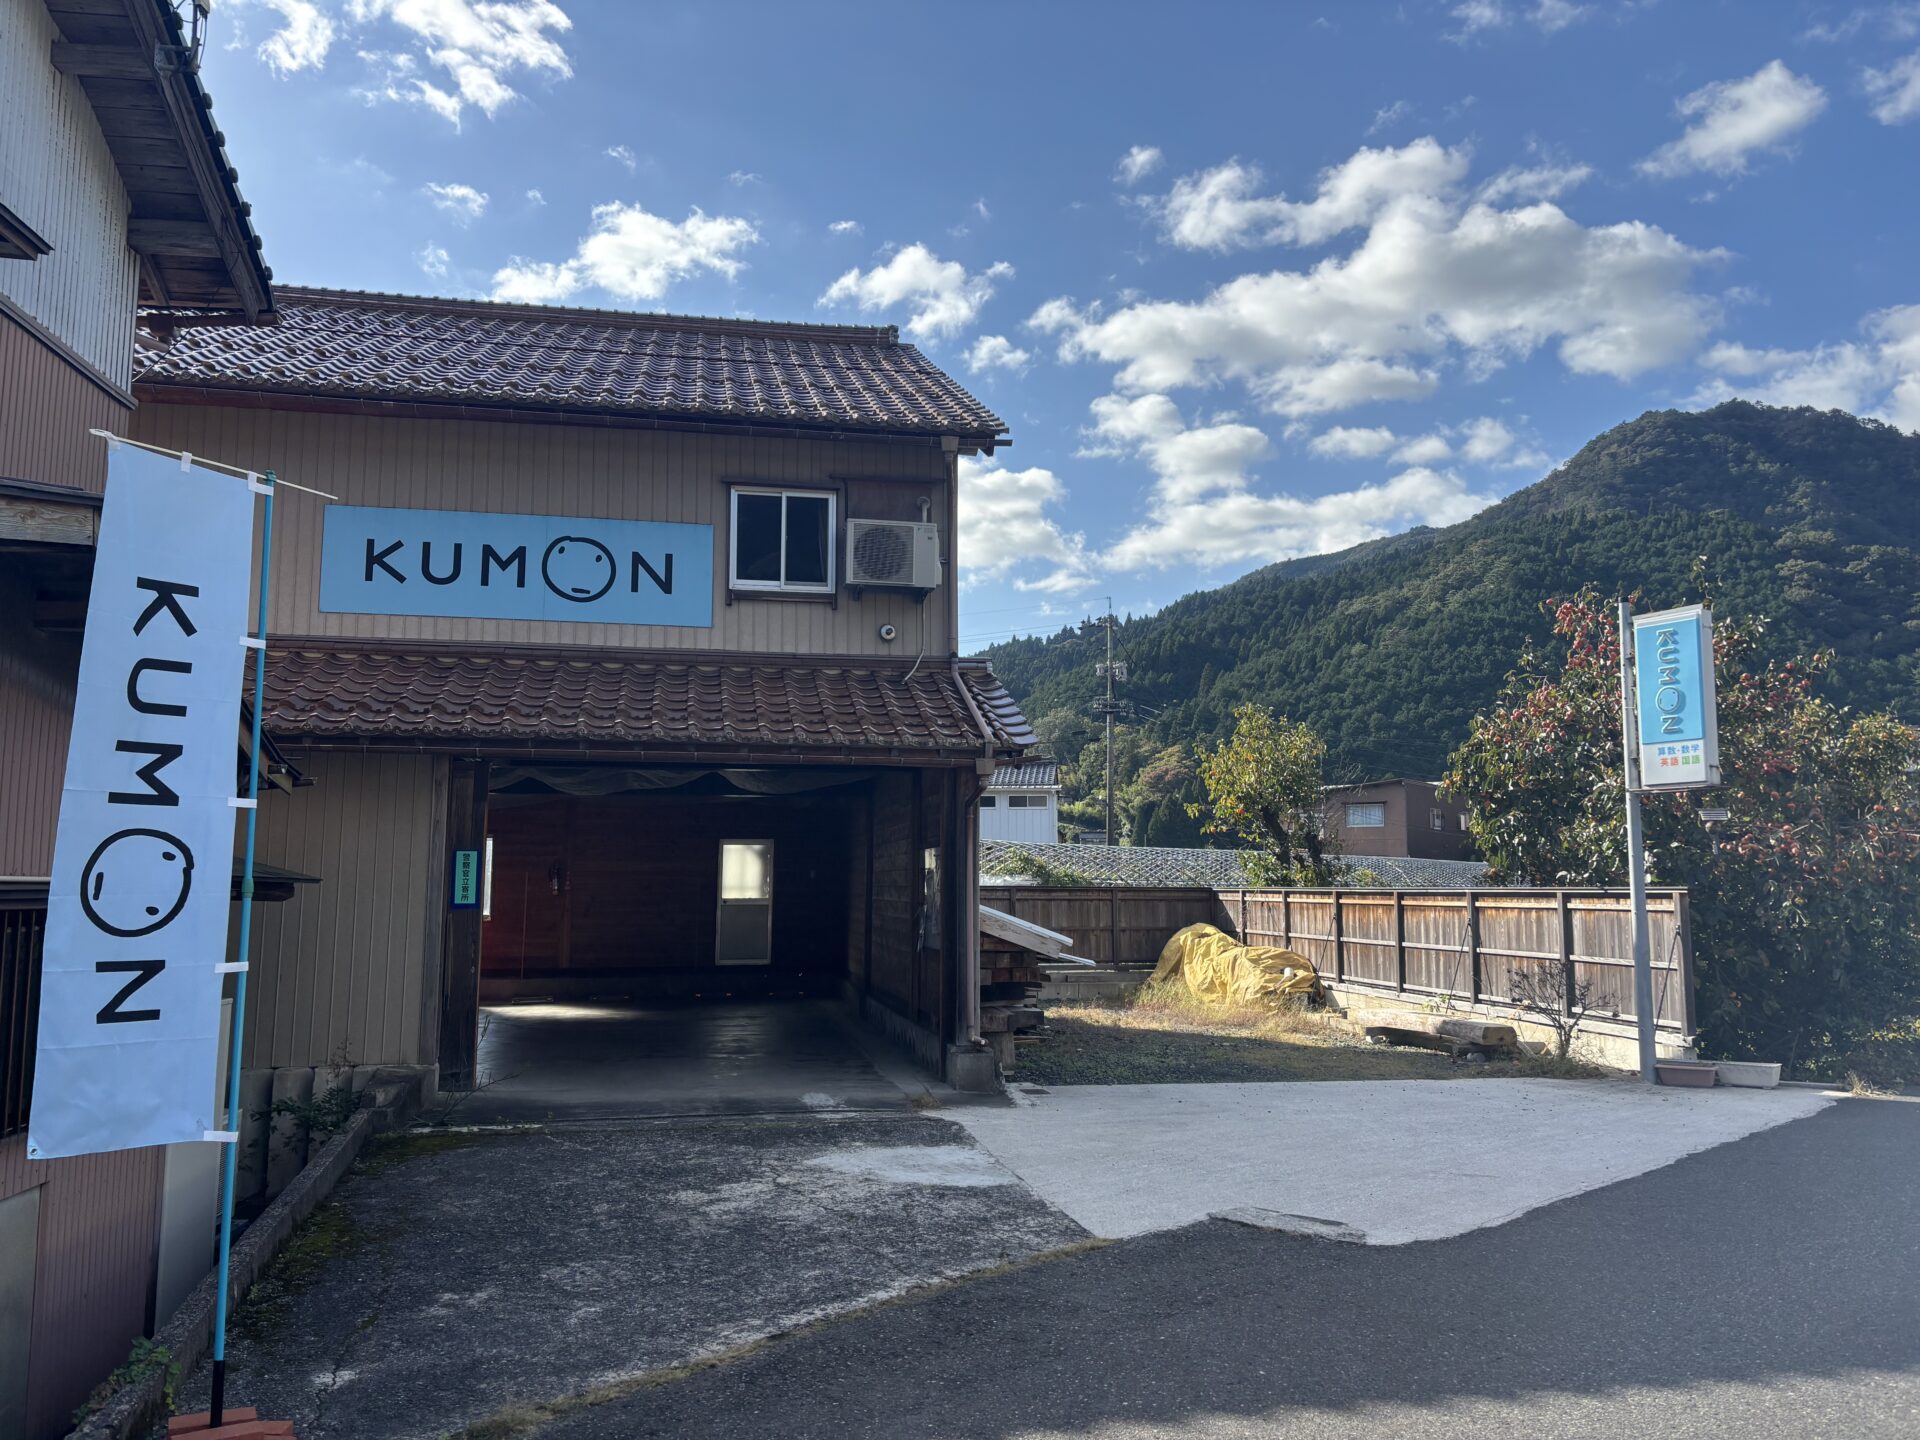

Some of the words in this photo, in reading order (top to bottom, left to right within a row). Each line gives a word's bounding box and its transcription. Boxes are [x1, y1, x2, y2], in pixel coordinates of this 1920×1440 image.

[364, 535, 674, 603] KUMON
[1655, 628, 1684, 735] KUMON
[80, 576, 199, 1024] KUMON
